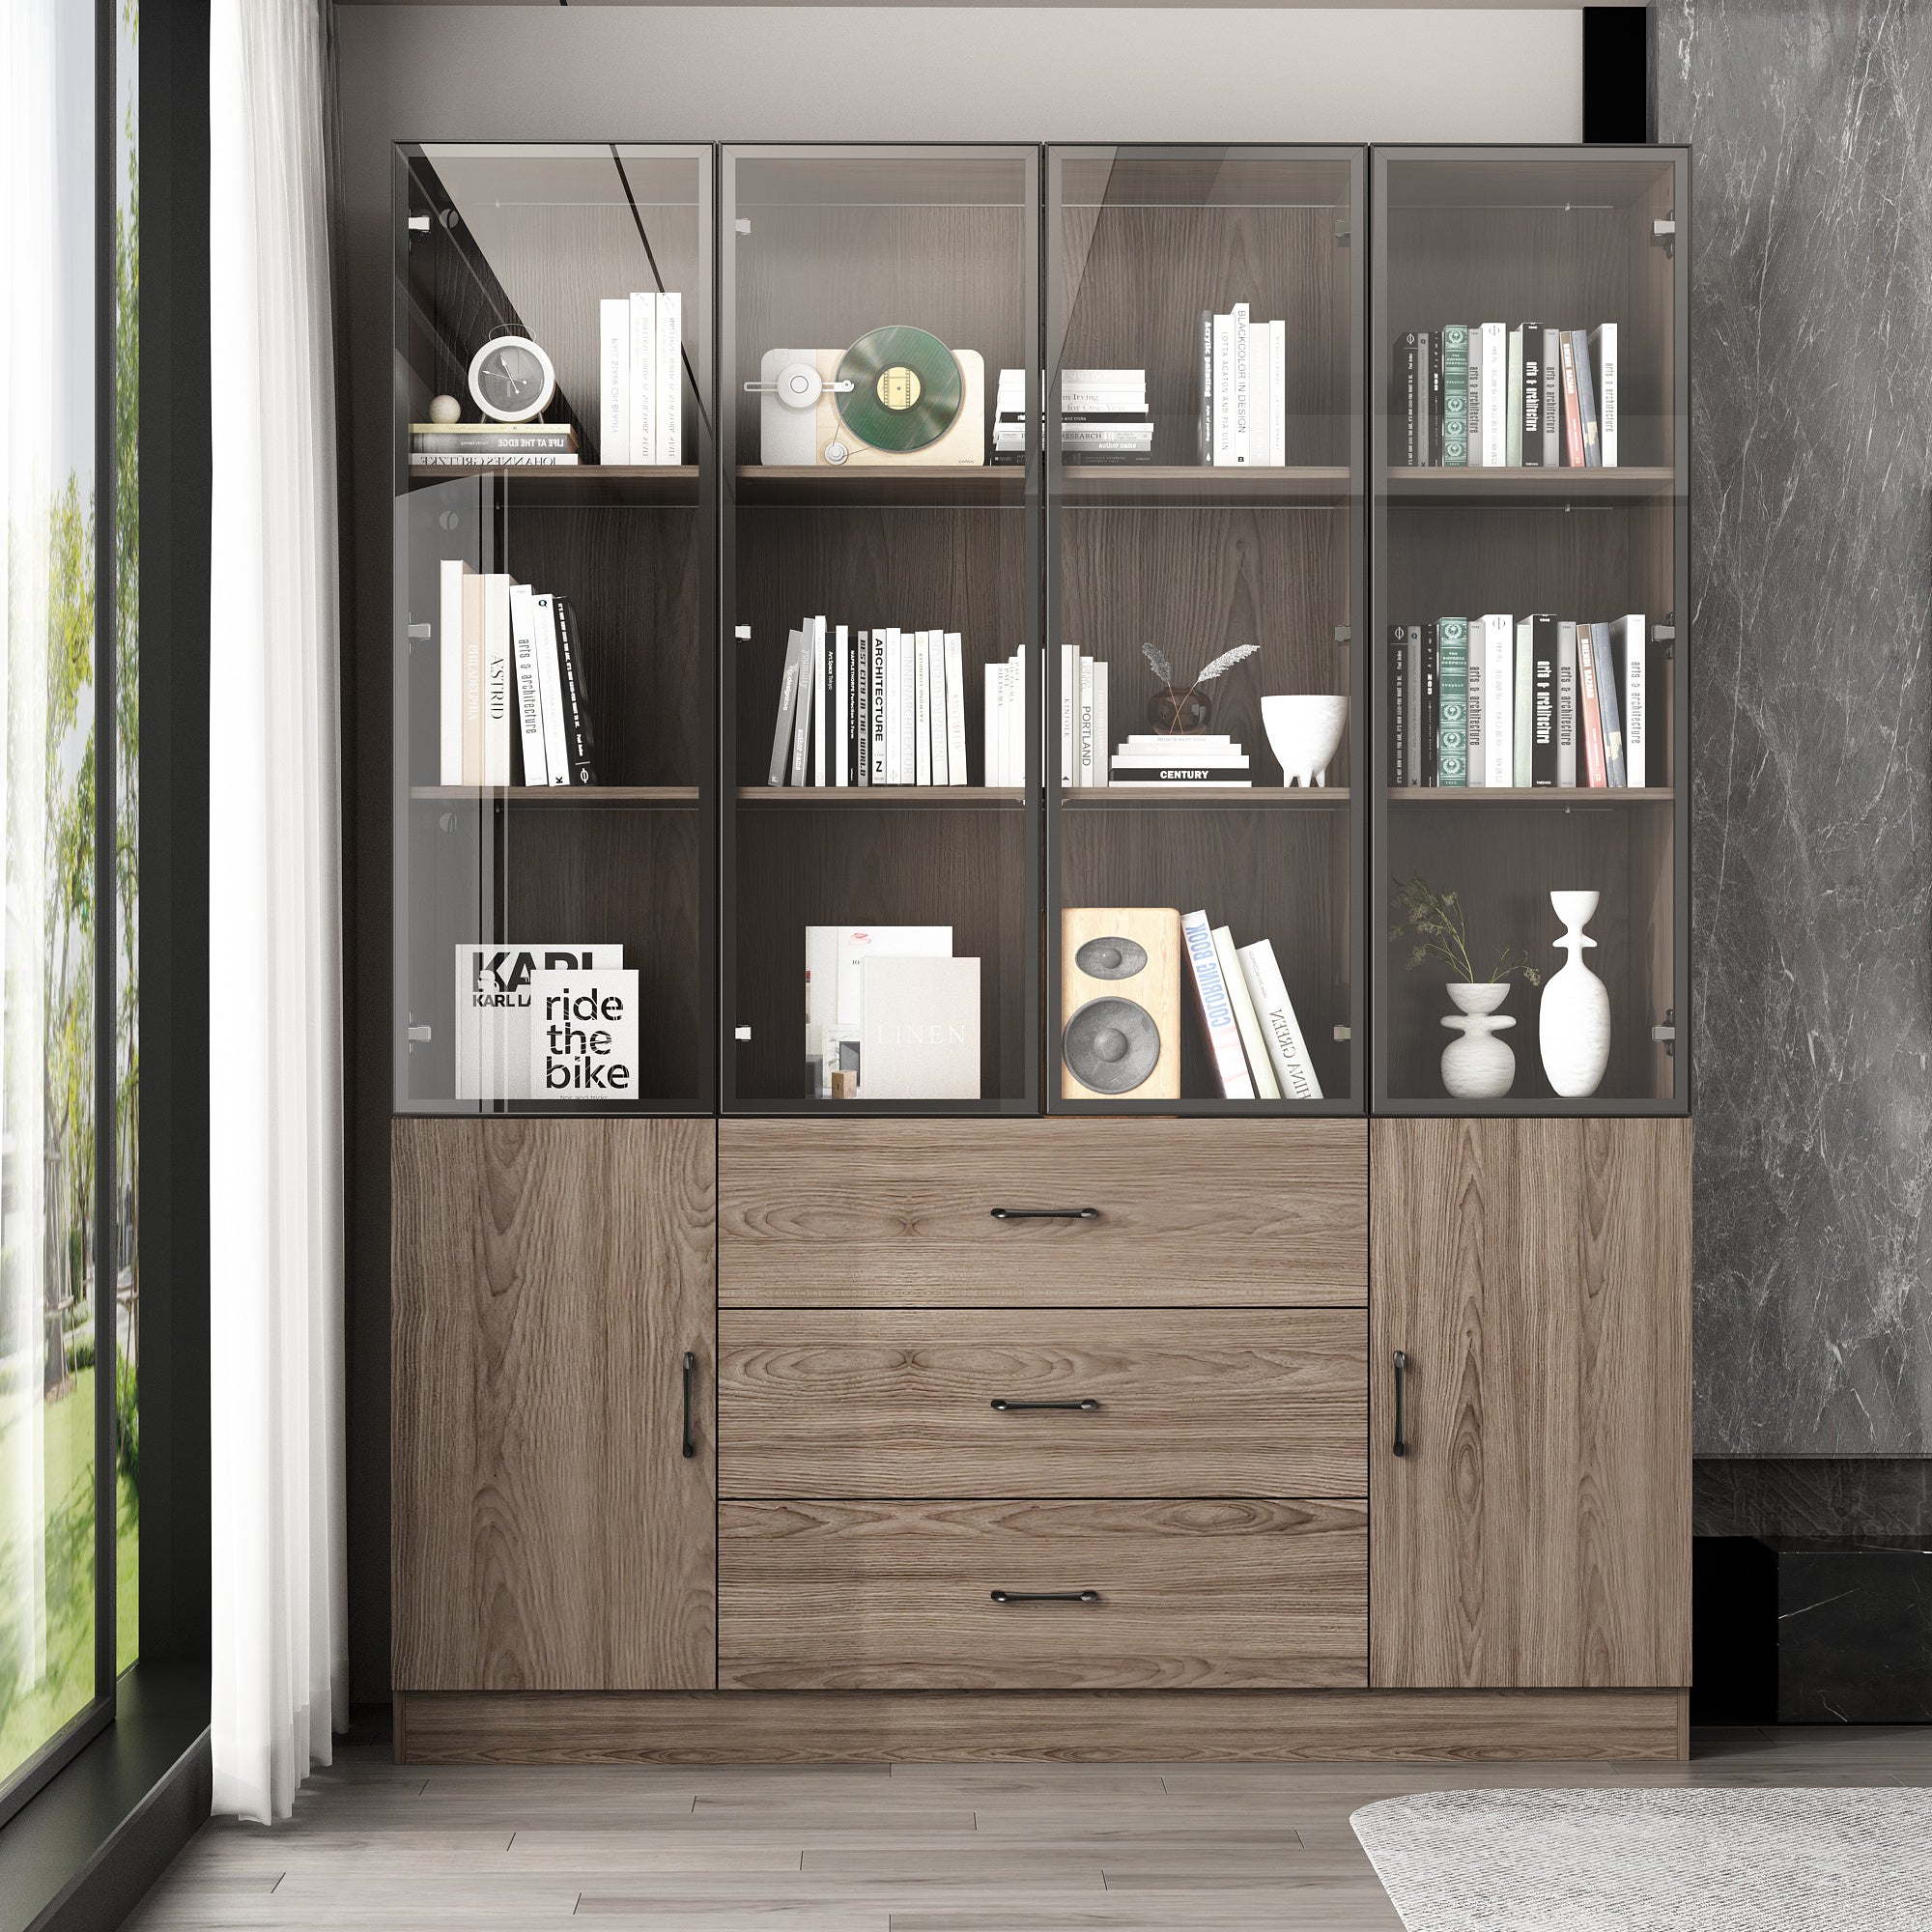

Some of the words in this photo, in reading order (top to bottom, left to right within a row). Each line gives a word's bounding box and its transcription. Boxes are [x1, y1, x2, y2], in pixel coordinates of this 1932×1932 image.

[1470, 366, 1478, 381] arts
[1526, 362, 1538, 376] arts
[1546, 366, 1555, 381] arts
[1470, 391, 1479, 434] architecture
[1526, 388, 1538, 432] architecture
[1546, 391, 1556, 434] architecture
[1605, 389, 1614, 432] architecture
[519, 639, 530, 658] arts
[1470, 666, 1480, 682] arts
[1537, 661, 1551, 678] arts
[1561, 666, 1571, 682] arts
[1631, 662, 1640, 678] arts
[521, 674, 537, 734] architecture
[1537, 692, 1553, 744] architecture
[1631, 692, 1642, 744] architecture
[1082, 706, 1091, 766] PORTLAND
[1470, 696, 1482, 746] architecture
[1561, 696, 1573, 746] architecture
[1160, 770, 1209, 779] CENTURY
[473, 952, 592, 992] KA
[473, 994, 515, 1007] KARL
[546, 988, 623, 1021] ride
[546, 1022, 612, 1054] the
[877, 1025, 965, 1044] LINEN
[546, 1056, 629, 1089] bike
